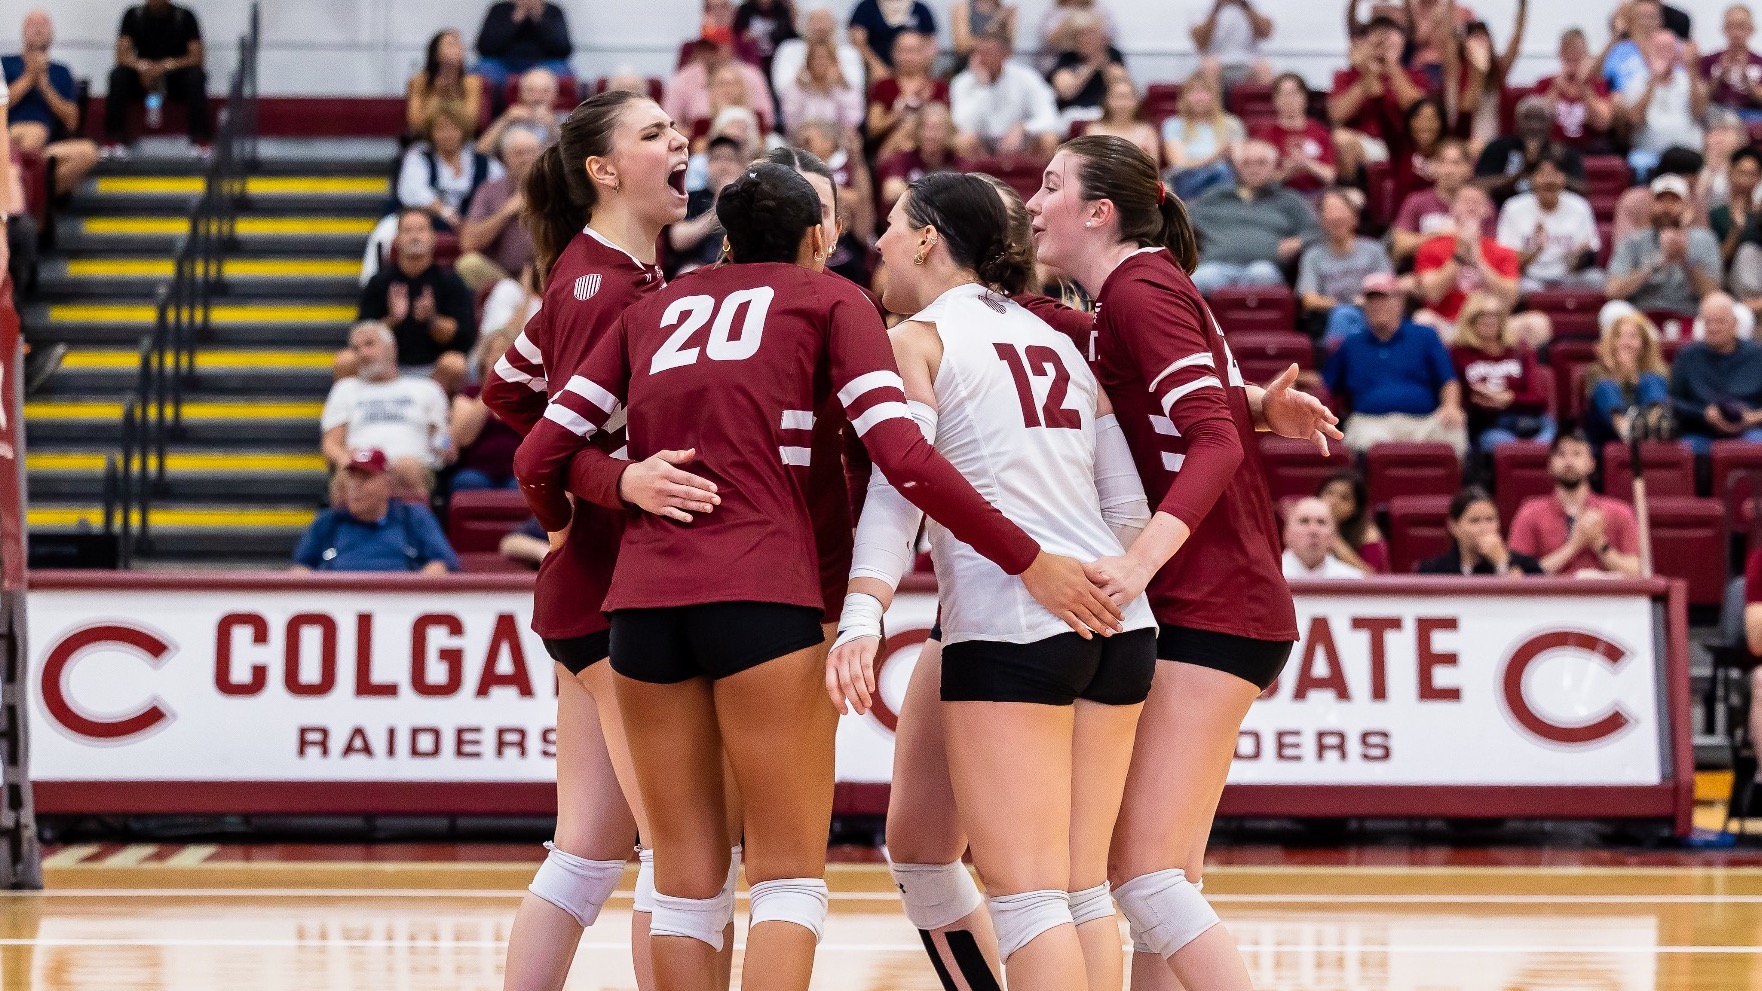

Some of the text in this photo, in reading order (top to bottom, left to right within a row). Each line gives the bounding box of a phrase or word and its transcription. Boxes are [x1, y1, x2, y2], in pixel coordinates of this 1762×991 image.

[649, 285, 775, 376] 20
[992, 342, 1082, 430] 12
[39, 622, 174, 742] C
[214, 612, 560, 698] COLGA
[1500, 627, 1634, 746] C
[1234, 729, 1391, 762] DERS
